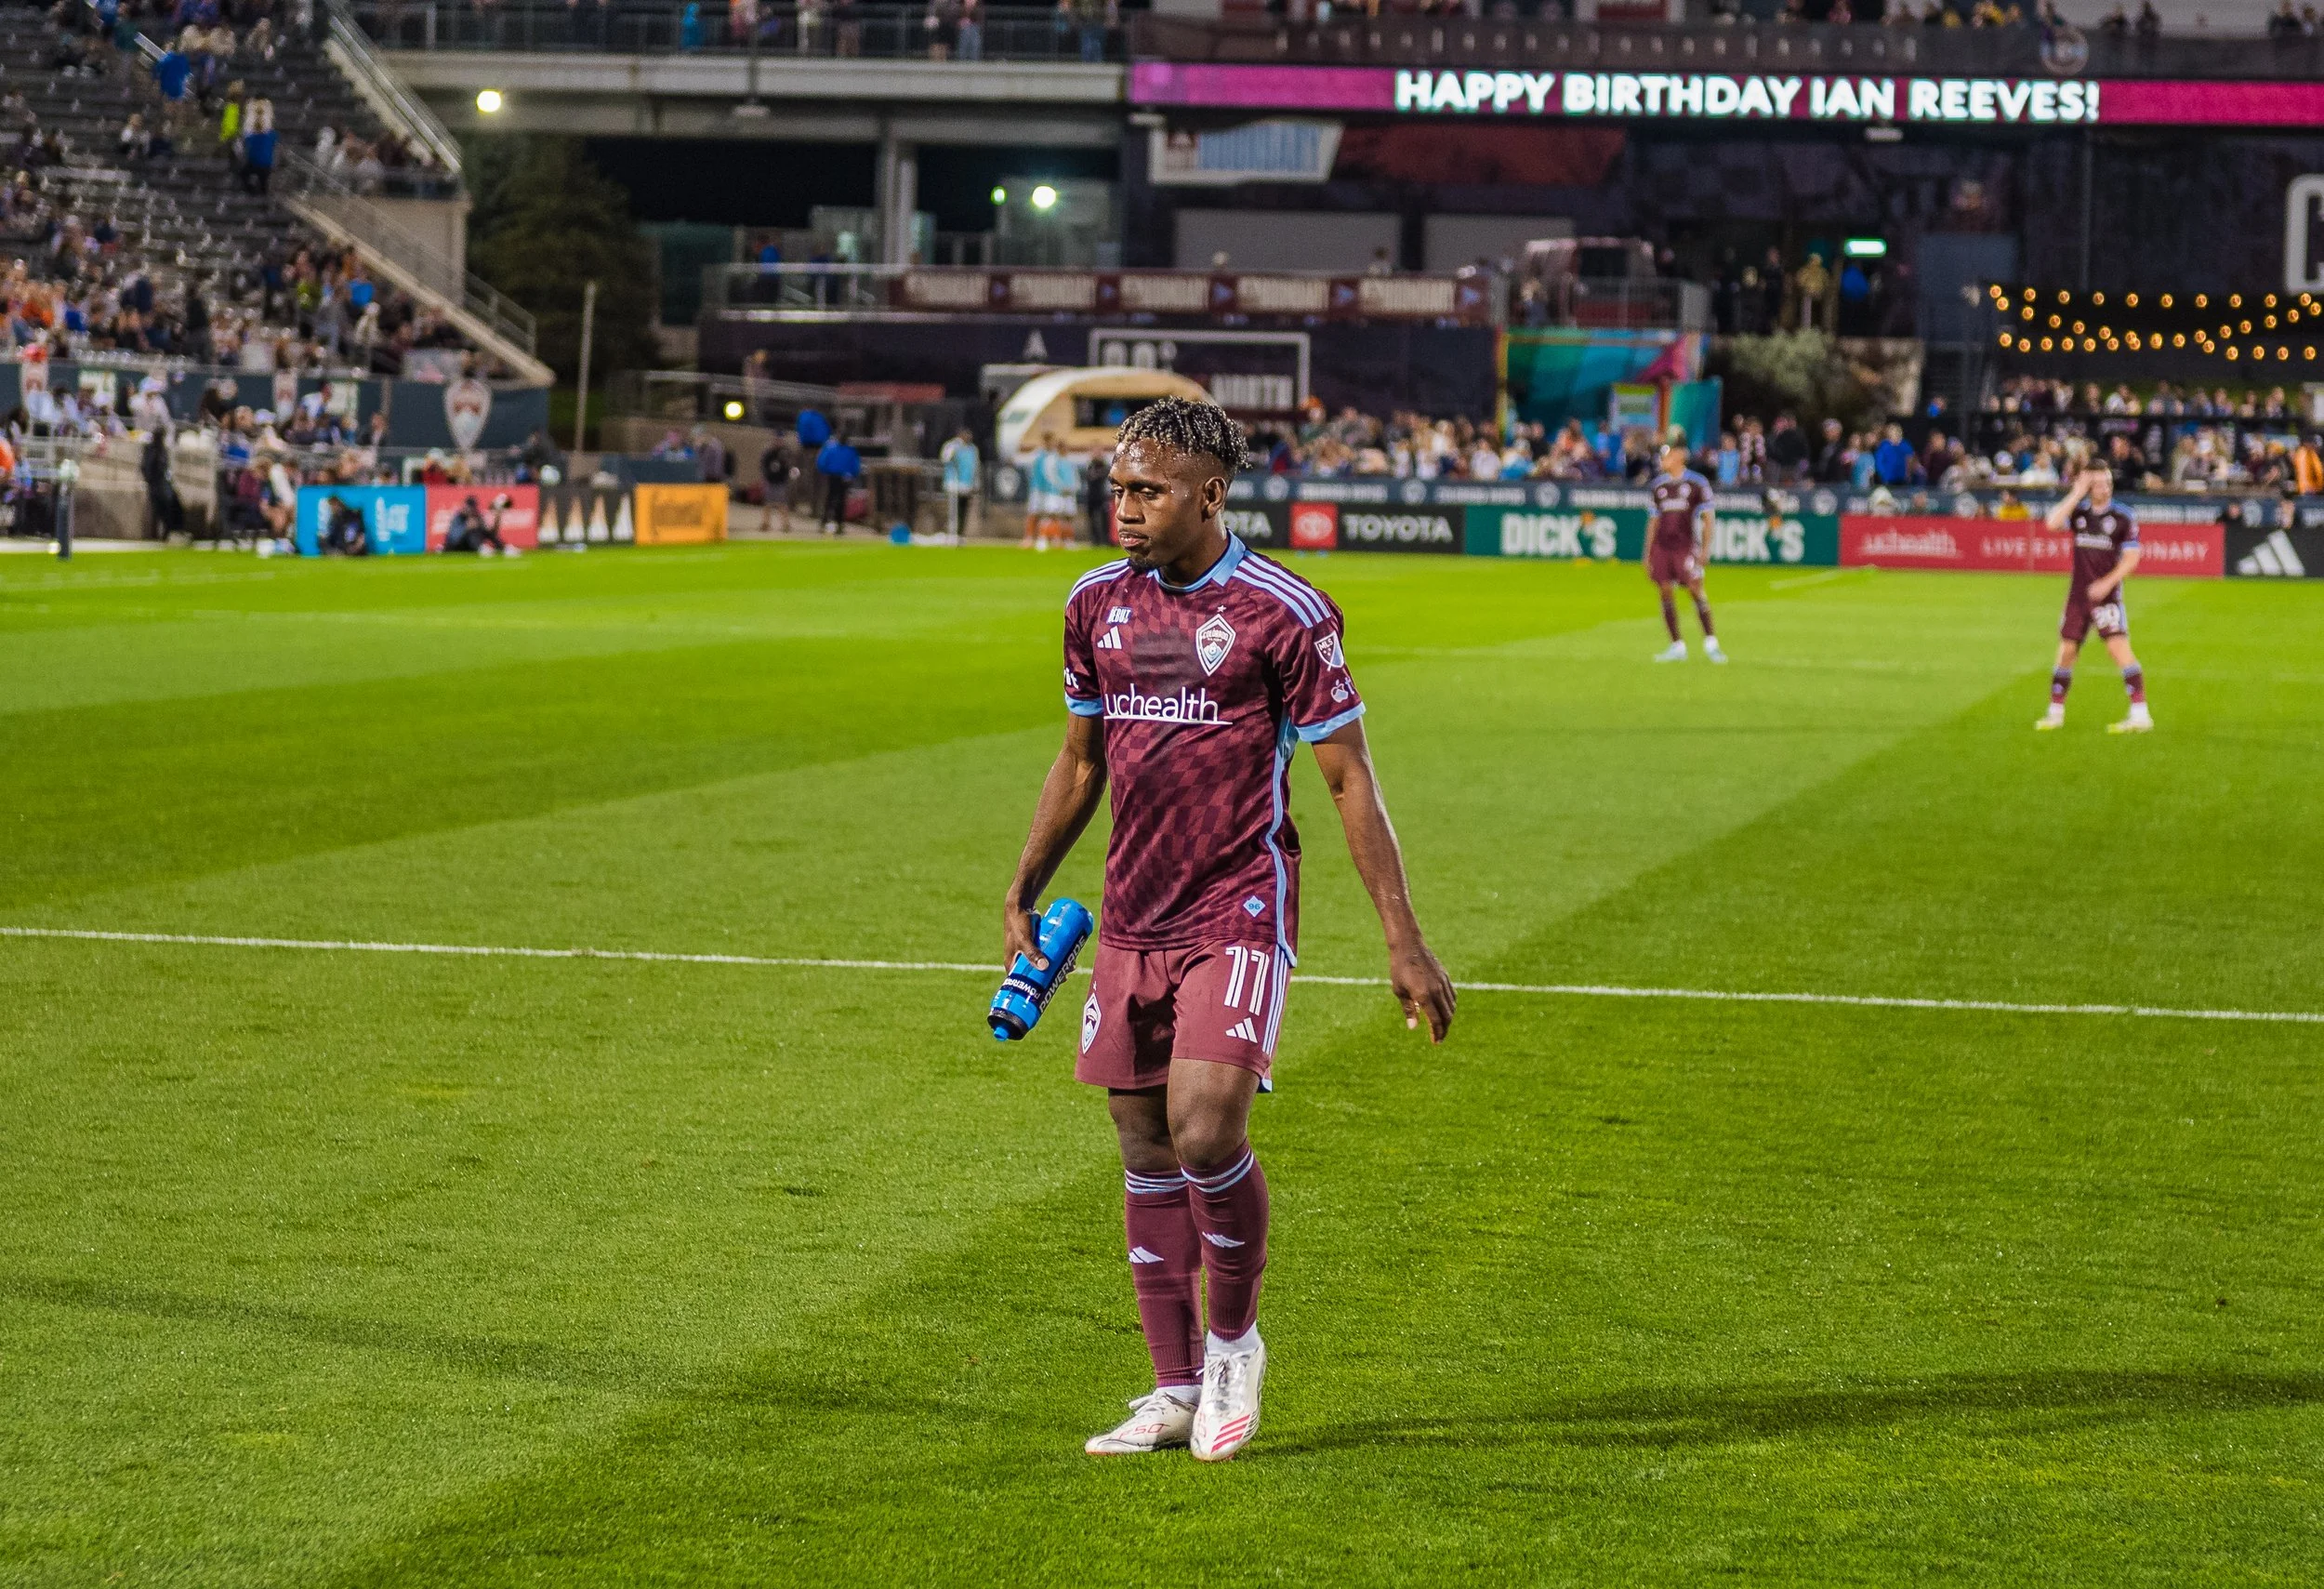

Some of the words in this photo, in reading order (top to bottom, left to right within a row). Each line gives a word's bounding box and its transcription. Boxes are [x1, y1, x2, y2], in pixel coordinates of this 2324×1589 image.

[1395, 70, 1555, 113] HAPPY
[1563, 73, 1802, 119] BIRTHDAY
[1809, 76, 1895, 120] IAN
[1908, 78, 2101, 123] REEVES!
[1222, 510, 1273, 539] OTA
[1342, 513, 1454, 543] TOYOTA
[1500, 511, 1618, 558] DICK'S
[1712, 517, 1805, 563] ICK'S
[1318, 638, 1334, 651] MLS
[1104, 682, 1220, 724] uchealth
[1038, 934, 1087, 1013] POWERADE
